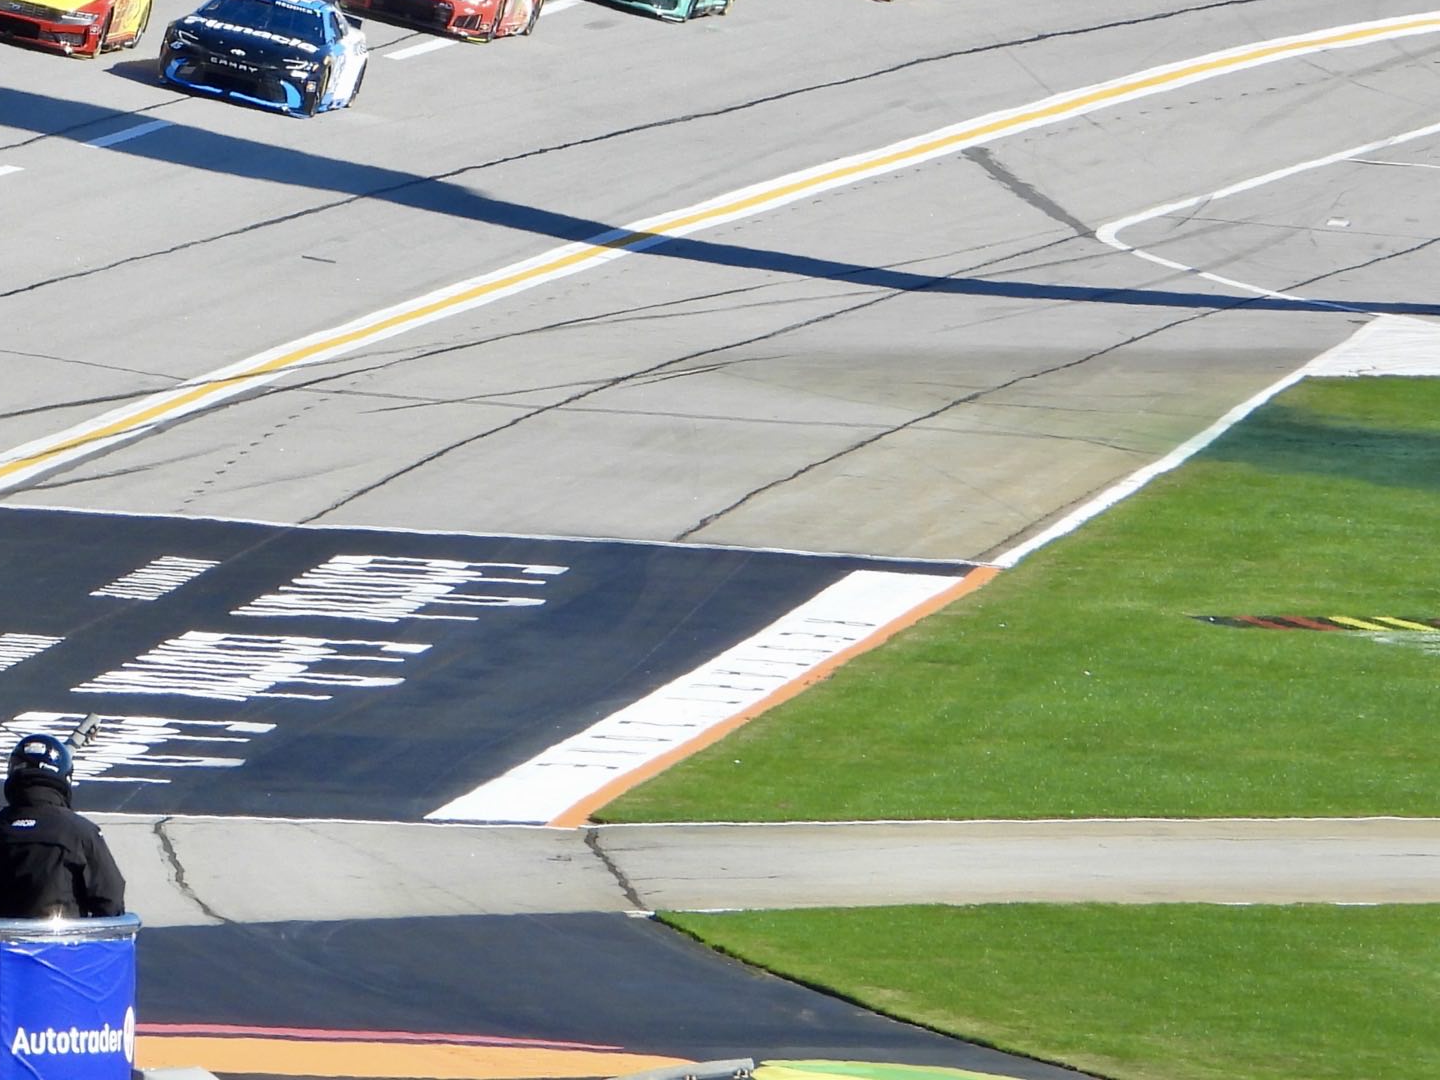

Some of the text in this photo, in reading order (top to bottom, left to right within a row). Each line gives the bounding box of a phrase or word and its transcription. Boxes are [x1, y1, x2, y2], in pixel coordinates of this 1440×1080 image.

[184, 16, 320, 54] Pinnacle
[210, 57, 258, 73] CAMRY
[11, 1022, 124, 1055] Autotrader
